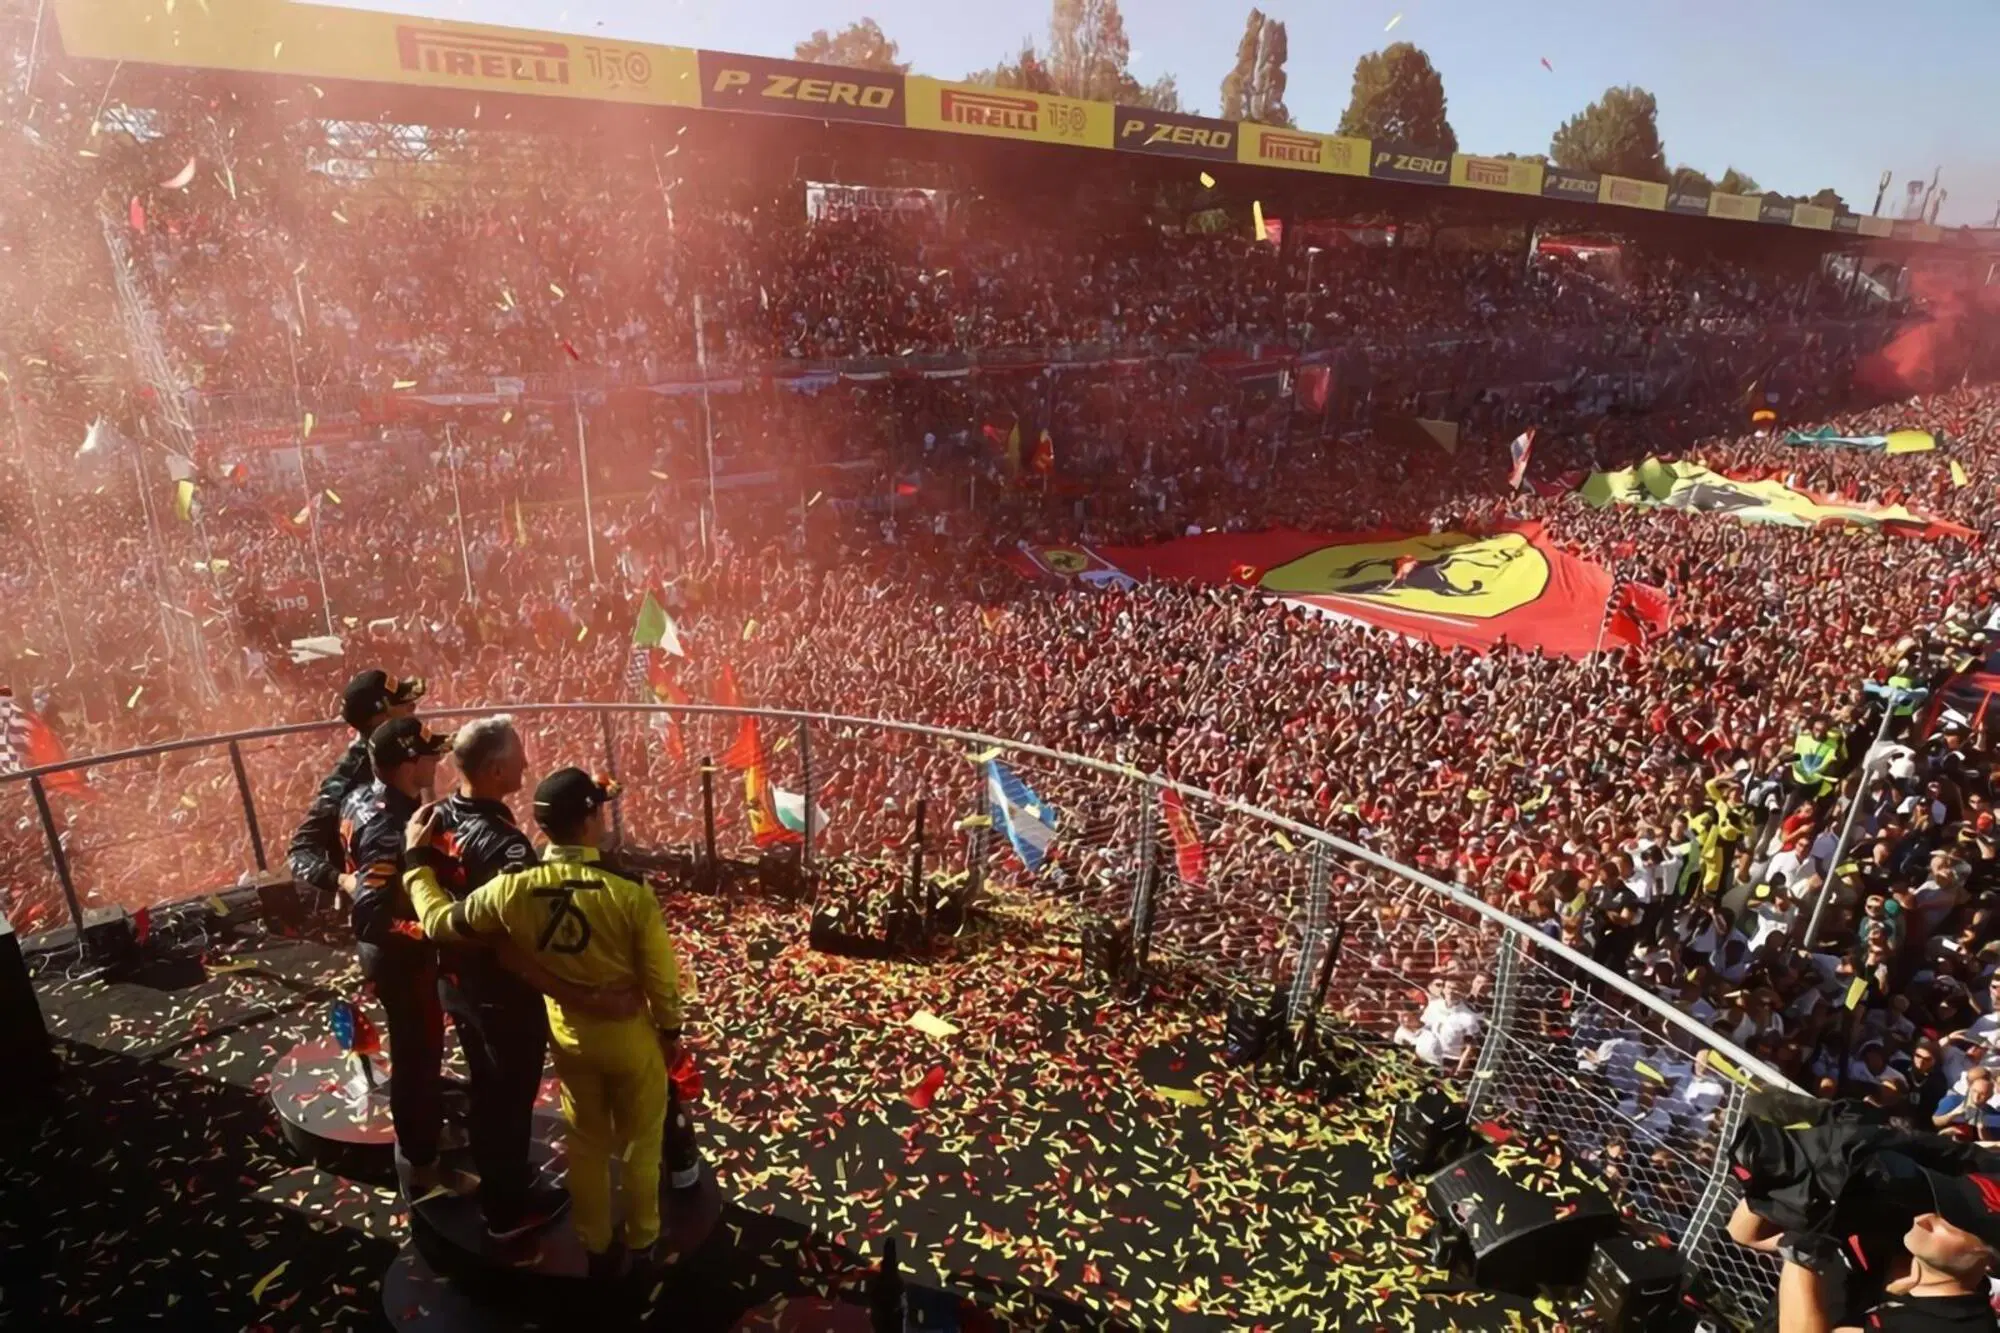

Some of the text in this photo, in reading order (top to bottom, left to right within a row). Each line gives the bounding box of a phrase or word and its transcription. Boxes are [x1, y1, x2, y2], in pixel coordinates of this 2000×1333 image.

[397, 24, 570, 84] PIRELLI
[712, 69, 896, 109] P ZERO
[940, 88, 1039, 132] PIRELLI
[1121, 119, 1233, 149] P ZERO
[1375, 152, 1391, 168] P
[1392, 154, 1448, 175] ZERO
